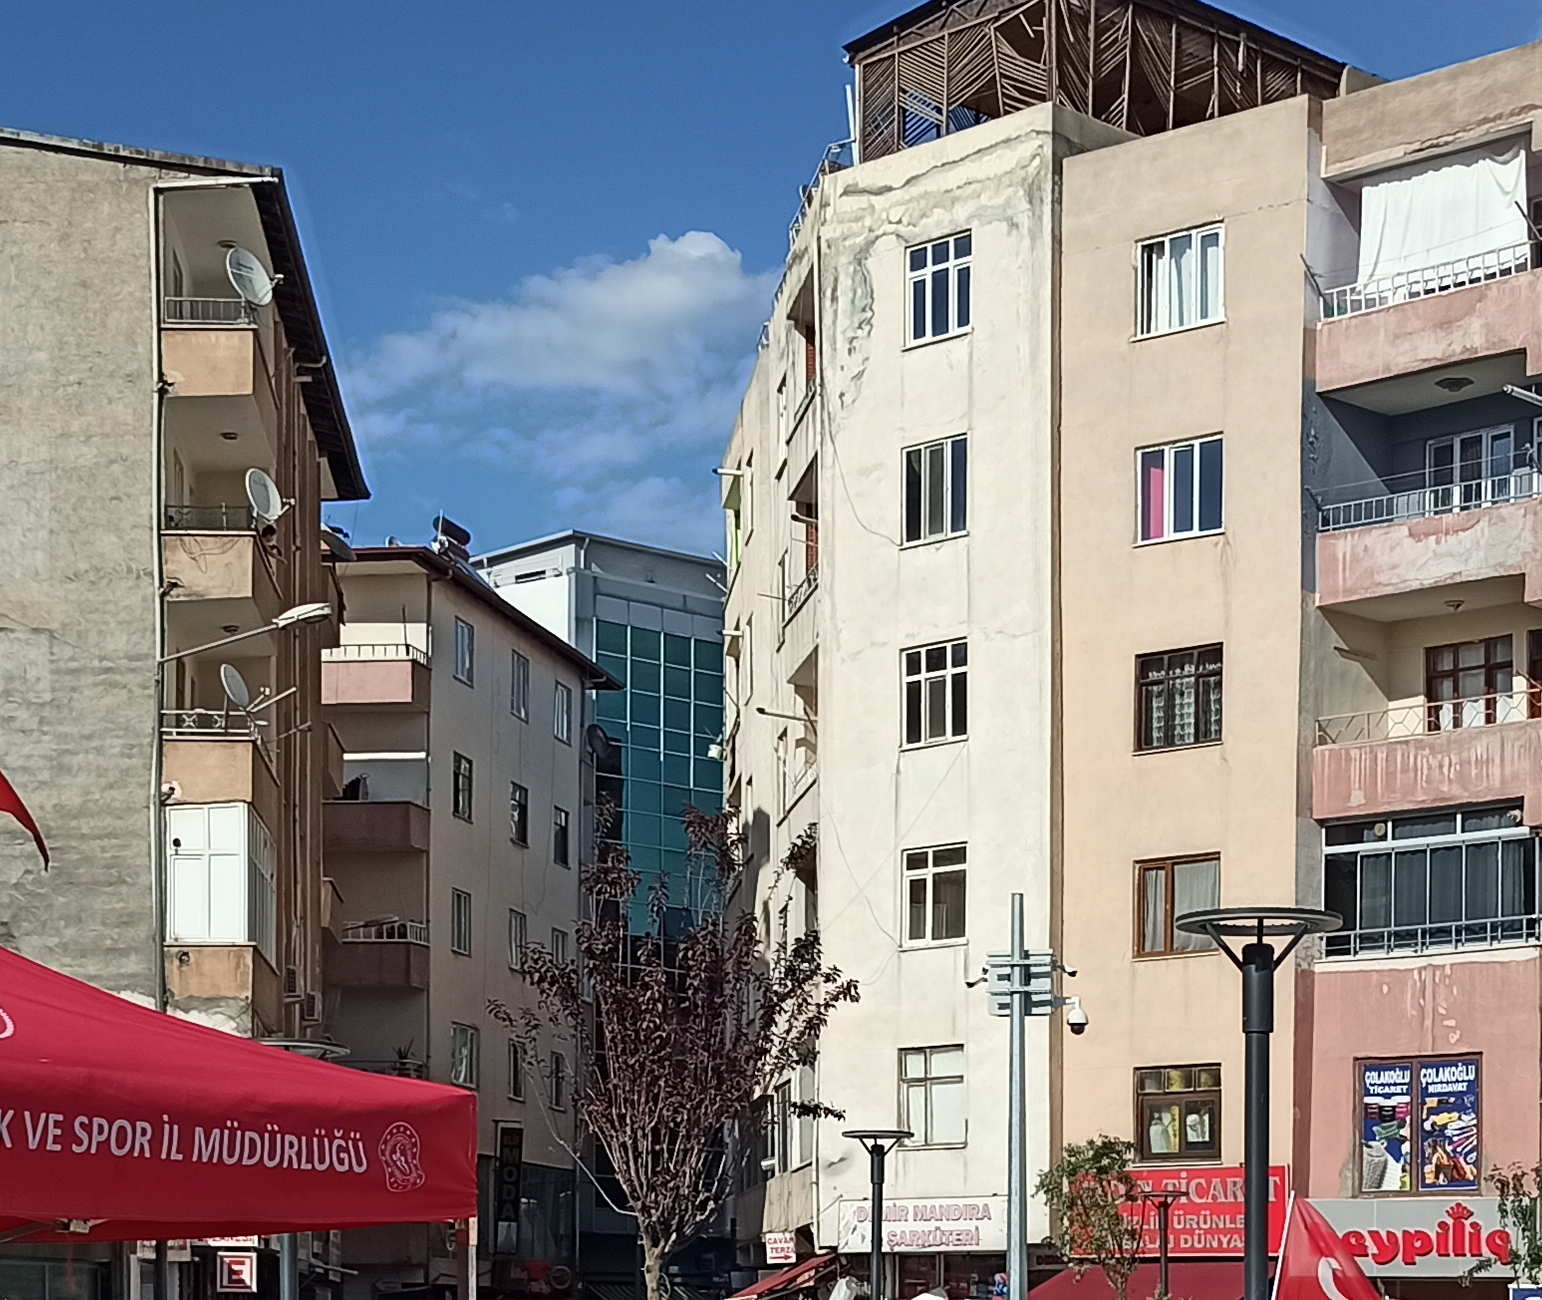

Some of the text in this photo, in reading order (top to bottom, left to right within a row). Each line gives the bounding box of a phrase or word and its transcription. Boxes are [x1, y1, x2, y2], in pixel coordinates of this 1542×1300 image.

[1420, 1062, 1476, 1088] ÇOLAKOĞLU
[24, 1111, 63, 1152] VE
[72, 1115, 152, 1159] SPOR
[161, 1114, 184, 1161] İL
[192, 1119, 368, 1174] MÜDÜRLÜĞÜ
[501, 1147, 519, 1219] MODA
[1161, 1171, 1281, 1204] TİCART
[856, 1203, 992, 1222] DMİR MANDIRA
[887, 1225, 981, 1250] ŞARKÜTERİ
